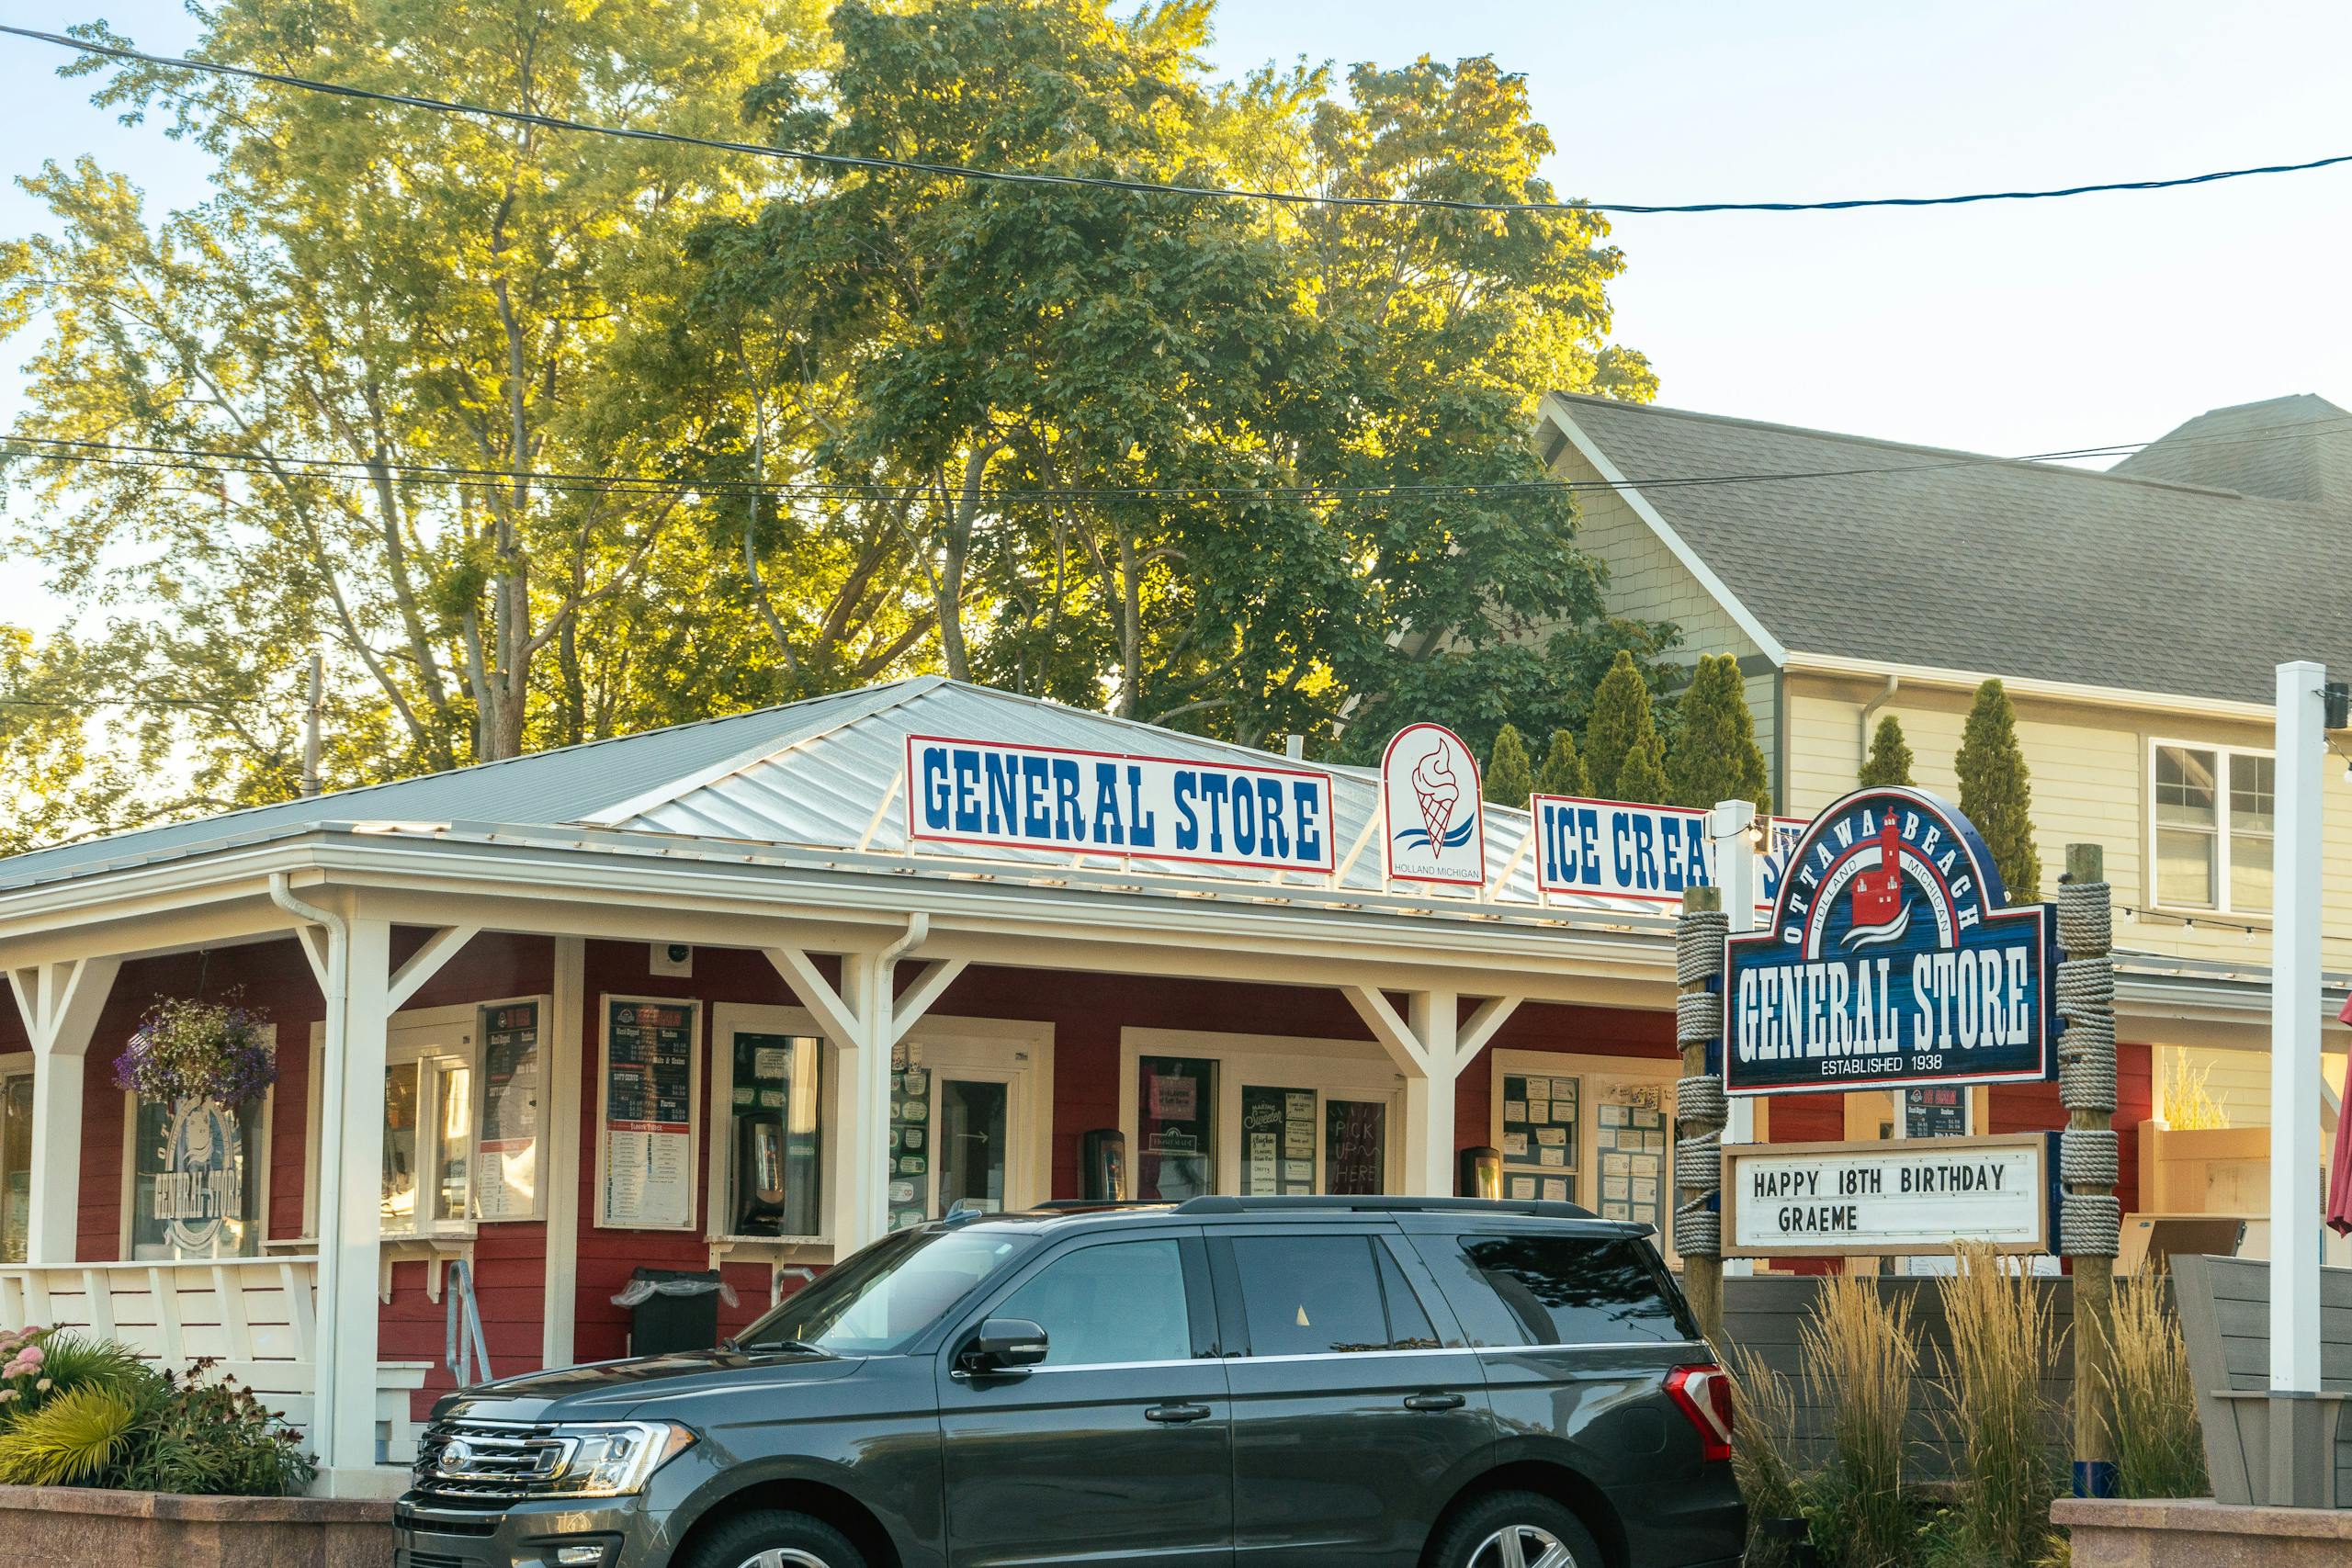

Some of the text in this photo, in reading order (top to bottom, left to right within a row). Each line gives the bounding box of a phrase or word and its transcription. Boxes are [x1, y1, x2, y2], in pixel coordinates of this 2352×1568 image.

[923, 747, 1321, 862] GENERAL STORE
[1544, 805, 1600, 886] ICE
[1611, 812, 1711, 892] CREA
[1395, 863, 1479, 878] HOLLAND MICHIGAN
[1784, 809, 1876, 944] OTTAWA
[1902, 811, 1980, 931] BEACH
[1814, 860, 1857, 931] HOLLAND
[1907, 859, 1949, 932] MICHIGAN
[1738, 946, 2029, 1063] GENERAL STORE
[1821, 1054, 1942, 1075] ESTABLISHED 1938
[1243, 1110, 1283, 1129] Sweeter
[1251, 1102, 1275, 1111] MAKING
[1335, 1120, 1374, 1140] PICK
[1335, 1142, 1356, 1160] UP
[154, 1169, 242, 1220] GENERAL STORE
[1754, 1164, 2005, 1197] HAPPY 18TH BIRTHDAY
[1778, 1205, 1858, 1232] GRAEME
